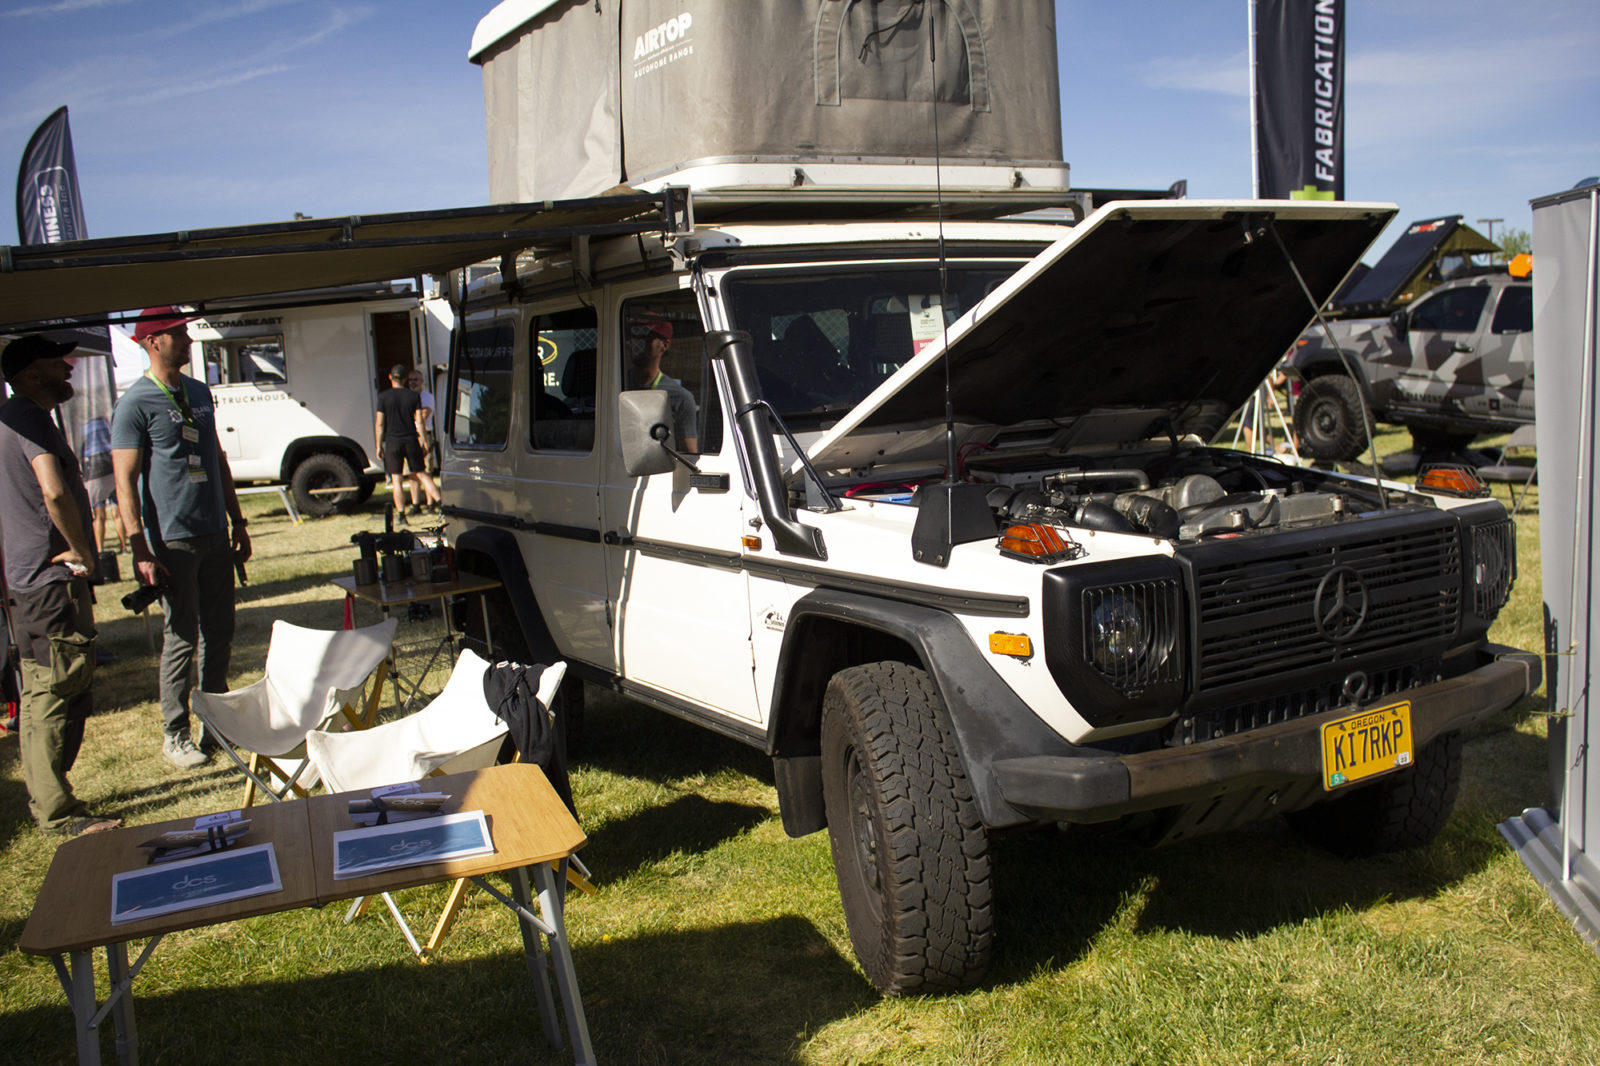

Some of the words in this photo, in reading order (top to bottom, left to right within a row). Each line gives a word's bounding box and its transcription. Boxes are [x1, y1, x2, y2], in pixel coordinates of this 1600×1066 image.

[633, 11, 692, 61] AIRTOP
[634, 57, 667, 78] AUTOHOME
[668, 45, 693, 63] RANGE
[1314, 0, 1335, 182] FABRICATION
[1351, 714, 1385, 730] OREGON
[1333, 719, 1403, 771] KI7RKP
[1334, 774, 1340, 784] 5
[171, 874, 217, 890] dcs
